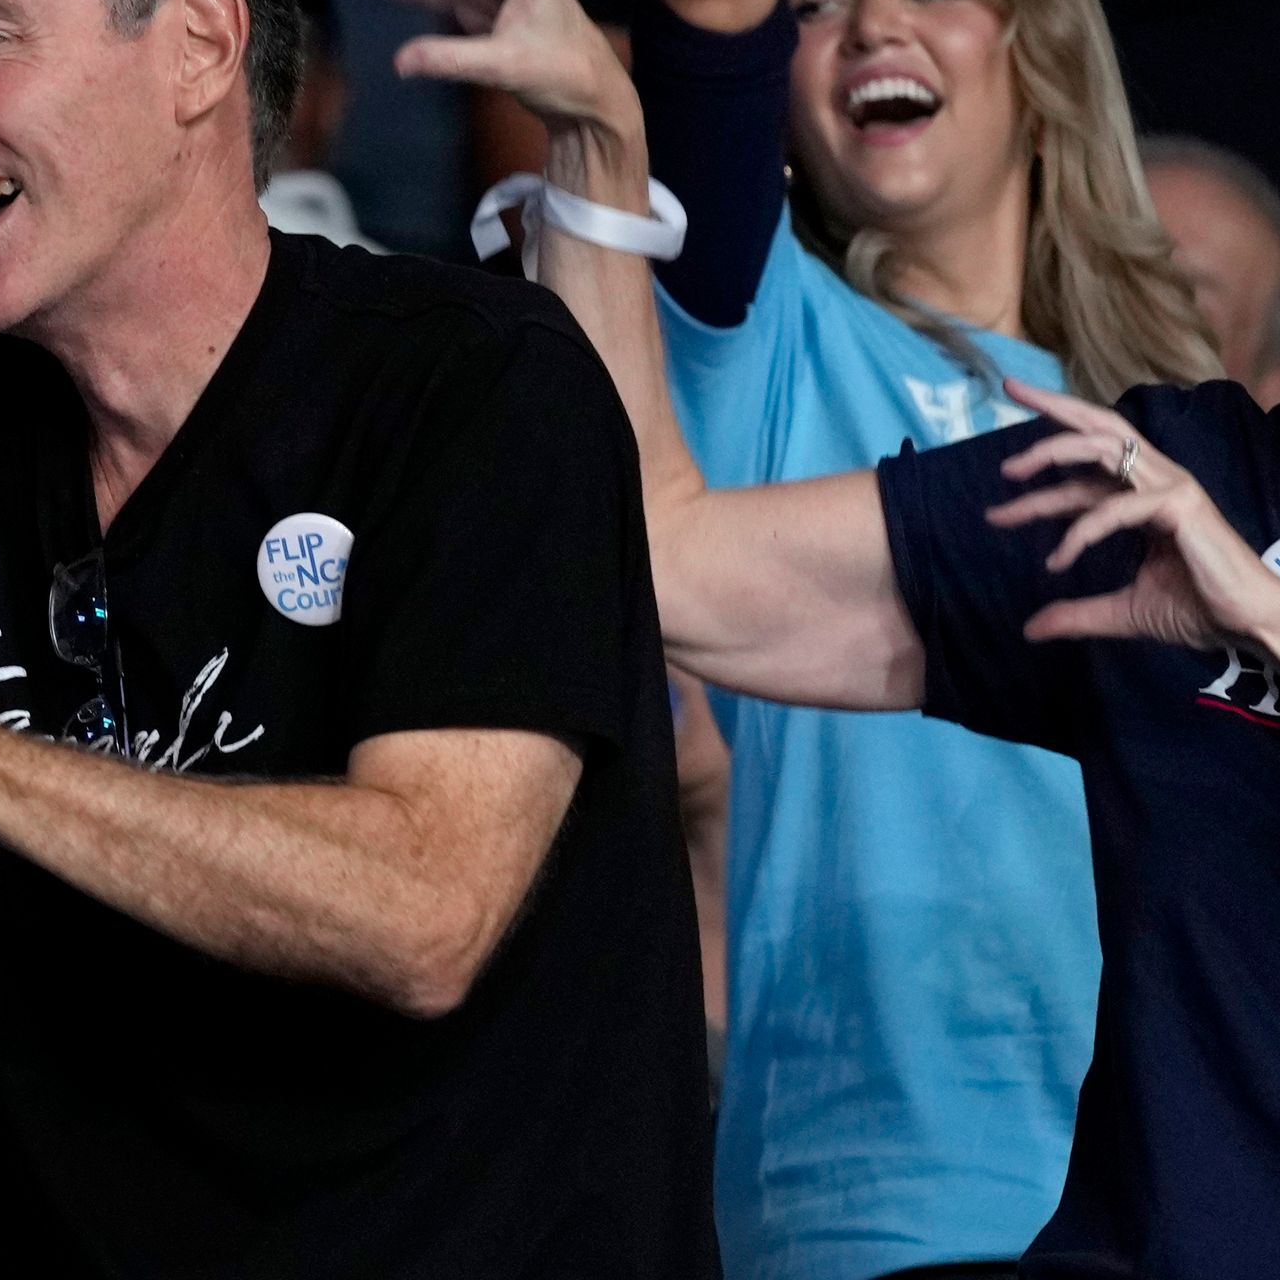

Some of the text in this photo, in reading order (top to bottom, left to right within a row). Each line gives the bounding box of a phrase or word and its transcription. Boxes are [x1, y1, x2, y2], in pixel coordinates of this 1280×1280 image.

[265, 533, 323, 564] FLIP
[273, 558, 341, 587] the NC
[277, 587, 341, 613] Cour
